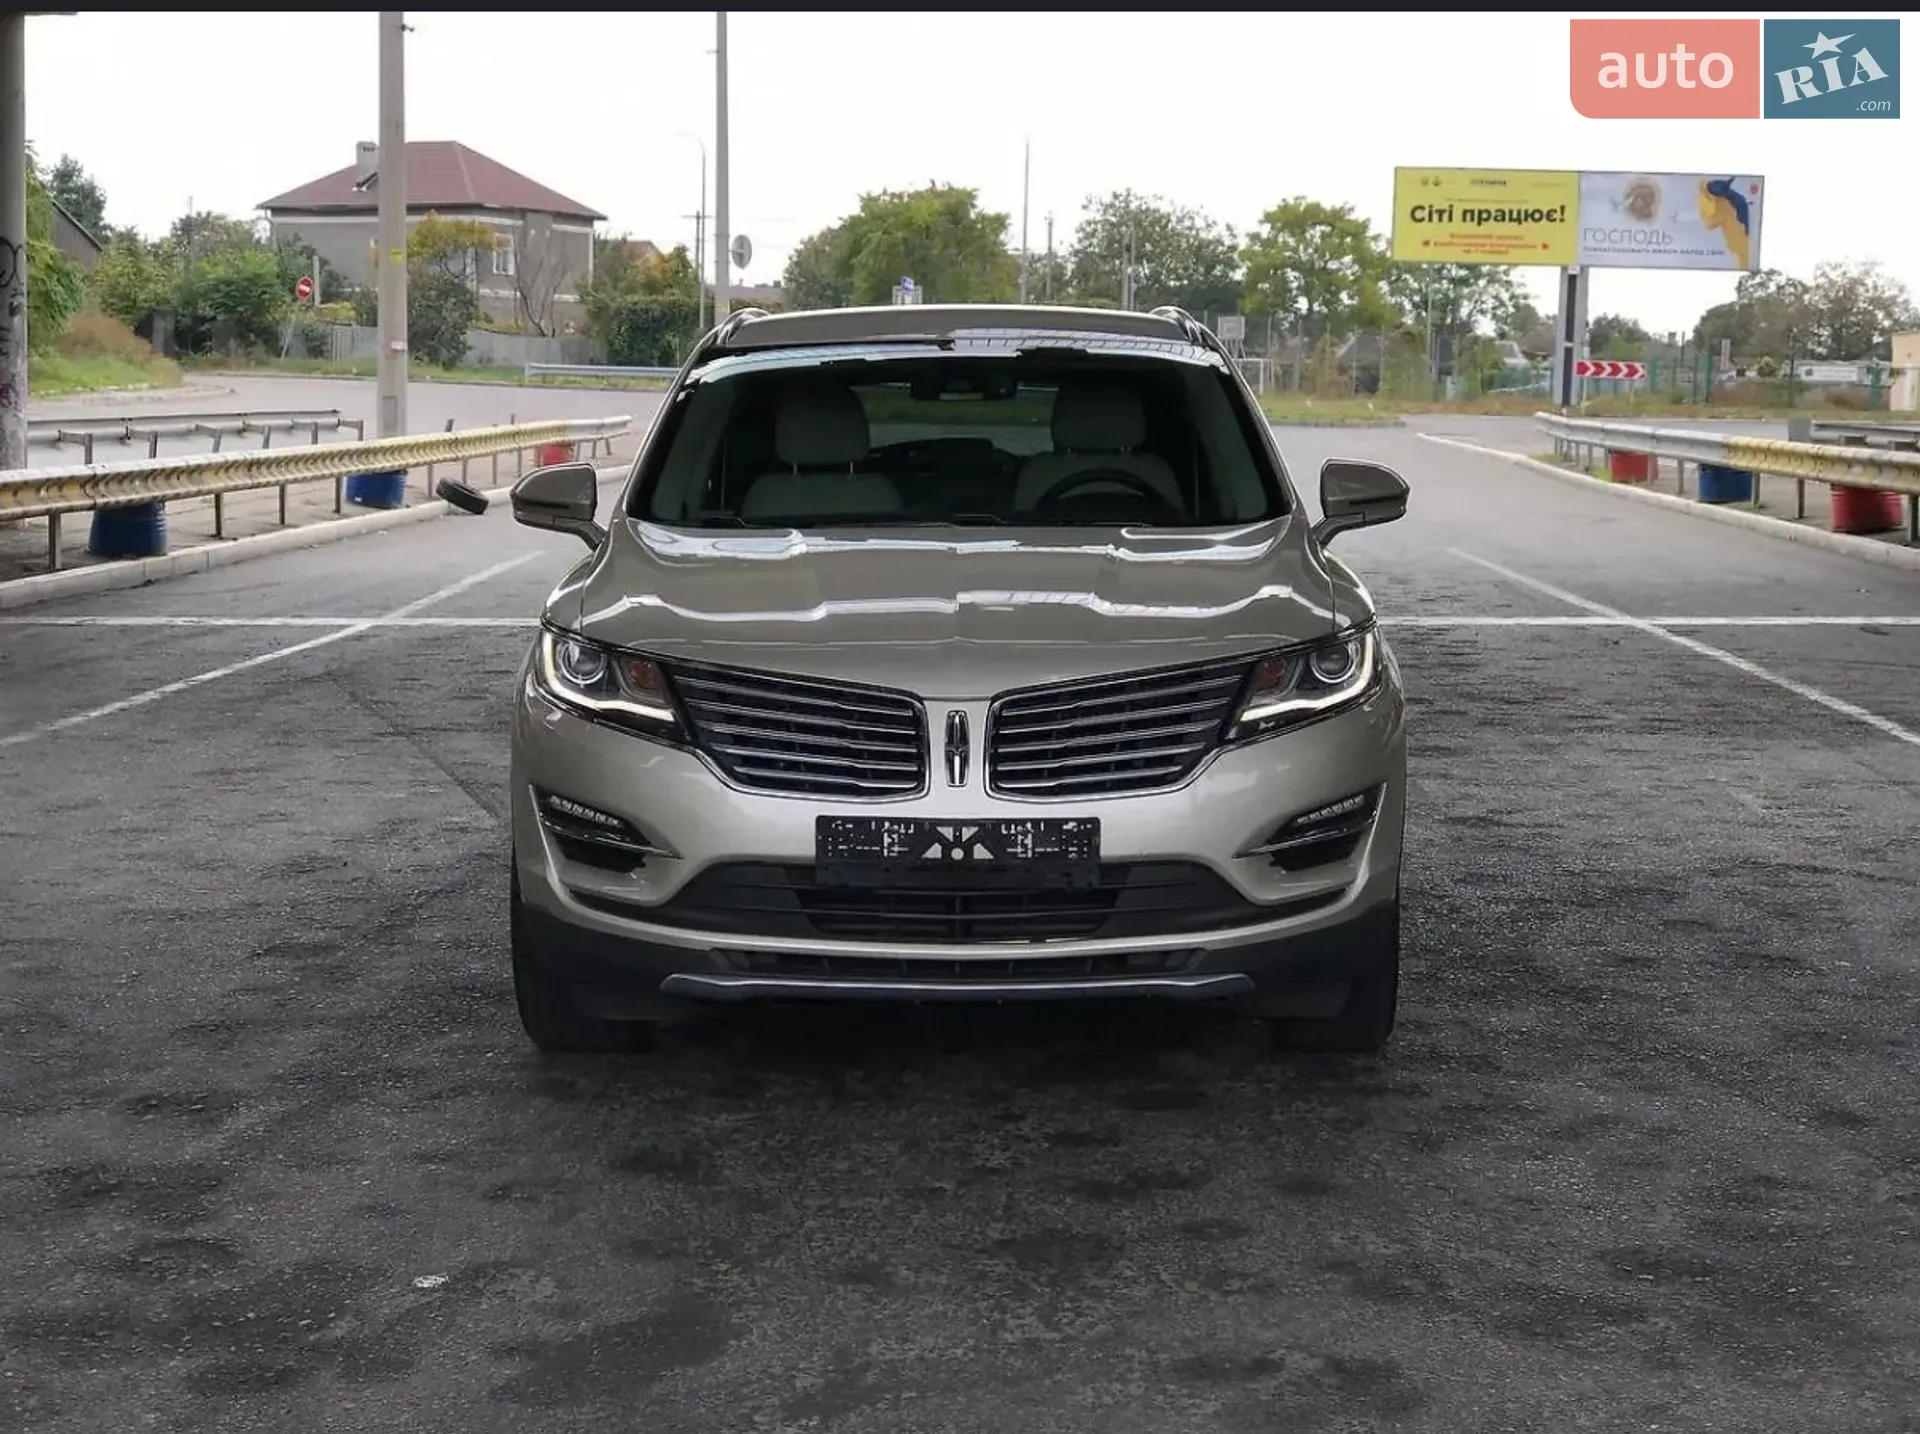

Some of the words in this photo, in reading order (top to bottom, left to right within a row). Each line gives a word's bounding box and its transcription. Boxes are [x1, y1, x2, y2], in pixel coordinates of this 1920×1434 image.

[1410, 204, 1454, 223] Сіті
[1461, 205, 1567, 226] працює!
[1584, 227, 1674, 246] ГОСПОДЬ
